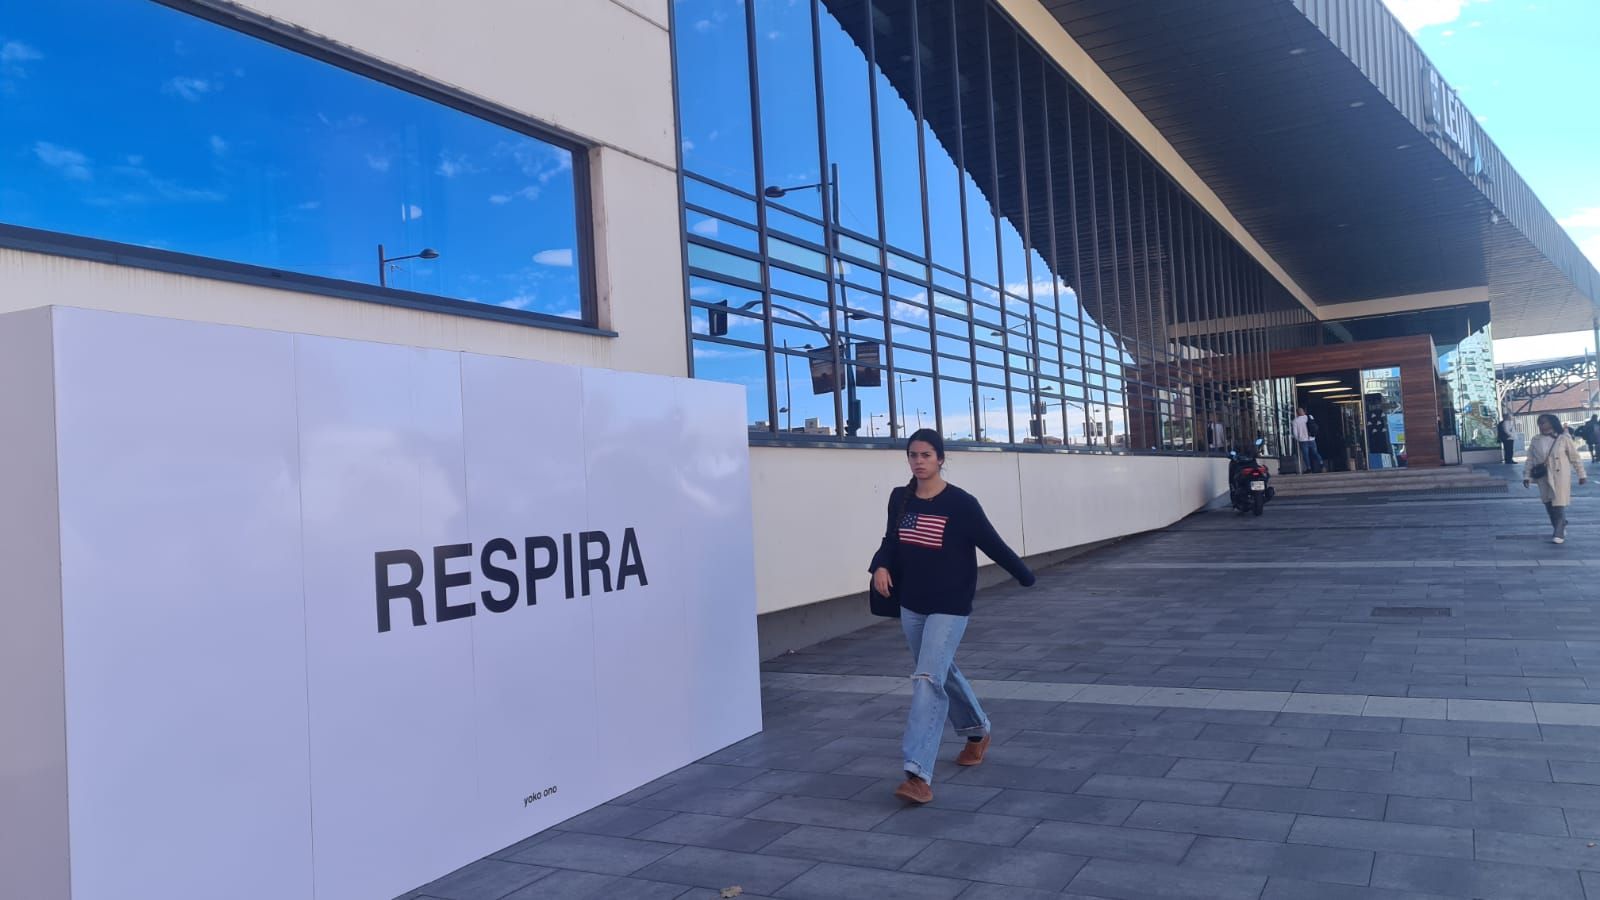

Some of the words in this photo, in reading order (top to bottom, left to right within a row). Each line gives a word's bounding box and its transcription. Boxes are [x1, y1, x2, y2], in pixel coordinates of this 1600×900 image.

[374, 527, 649, 633] RESPIRA
[523, 792, 542, 808] yoko
[543, 785, 558, 797] ono
